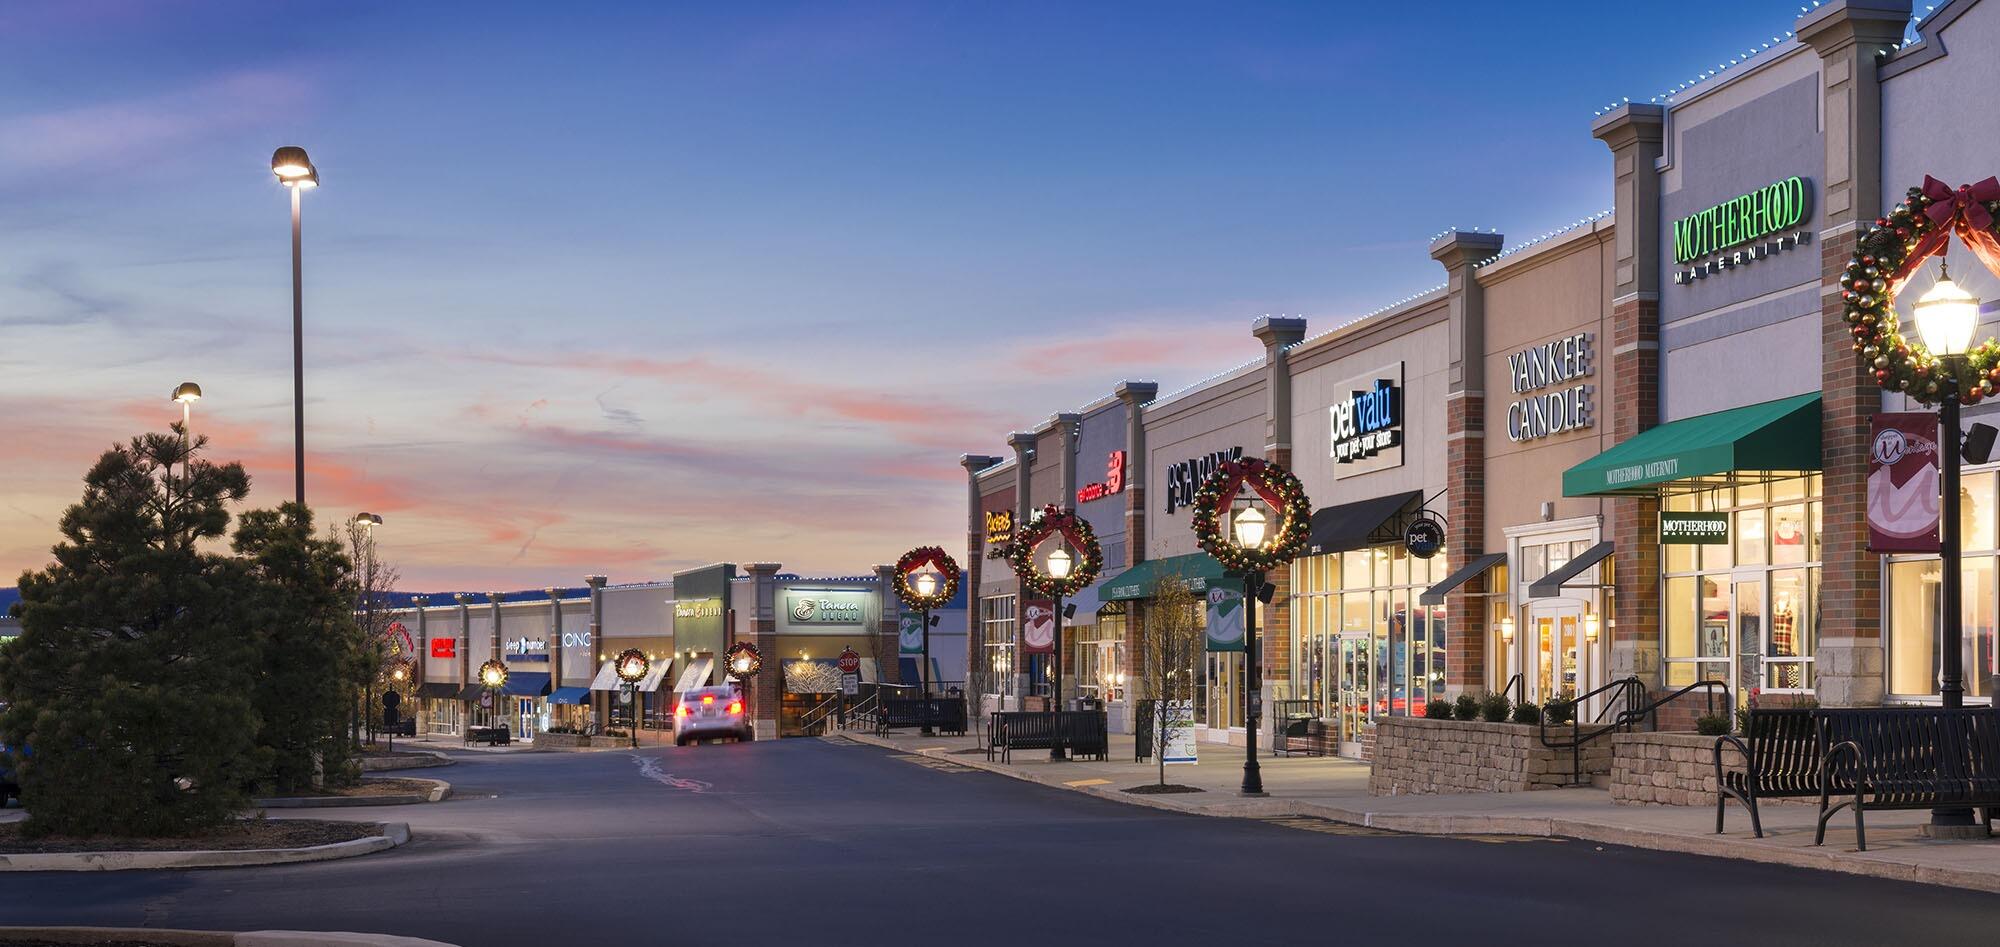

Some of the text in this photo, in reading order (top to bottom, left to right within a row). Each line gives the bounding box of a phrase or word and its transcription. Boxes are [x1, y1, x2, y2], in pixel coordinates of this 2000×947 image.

[1673, 176, 1804, 264] MOTHERHOOD
[1674, 231, 1801, 284] MATERNITY
[1506, 333, 1585, 393] YANKEE
[1329, 378, 1391, 458] pet valu
[1507, 385, 1585, 442] CANDLE
[1336, 430, 1392, 463] your pet your store
[1606, 458, 1679, 484] MOTHERHOOD MATERNITY
[1409, 532, 1428, 545] pet
[1663, 520, 1727, 532] MOTHERHOOD
[819, 599, 858, 610] Panera
[822, 611, 857, 620] BREAD
[505, 637, 546, 654] sleep number
[840, 657, 858, 667] STOP
